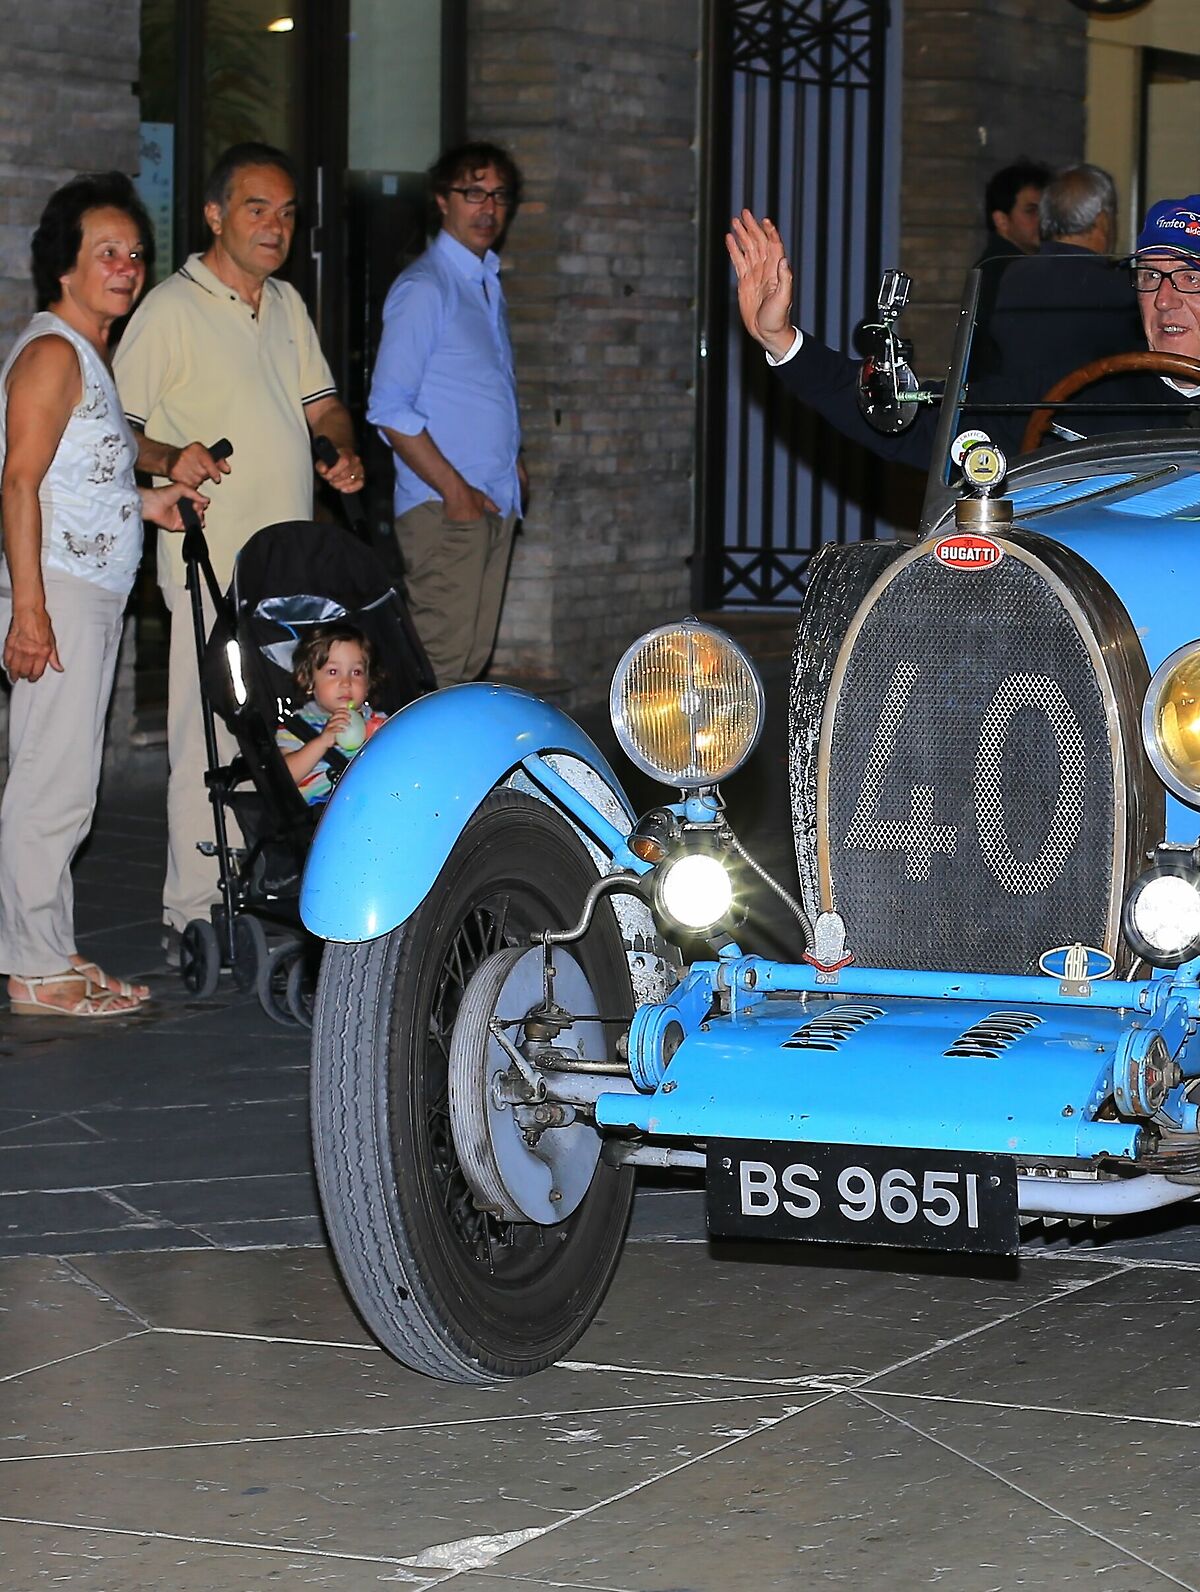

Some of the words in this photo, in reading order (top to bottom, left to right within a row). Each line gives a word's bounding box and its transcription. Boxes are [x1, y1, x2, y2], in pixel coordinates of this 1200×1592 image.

[956, 431, 990, 444] VERIFICAT
[940, 546, 995, 562] BUGATTI
[844, 659, 1086, 895] 40
[739, 1160, 821, 1219] BS
[837, 1166, 979, 1228] 9651
